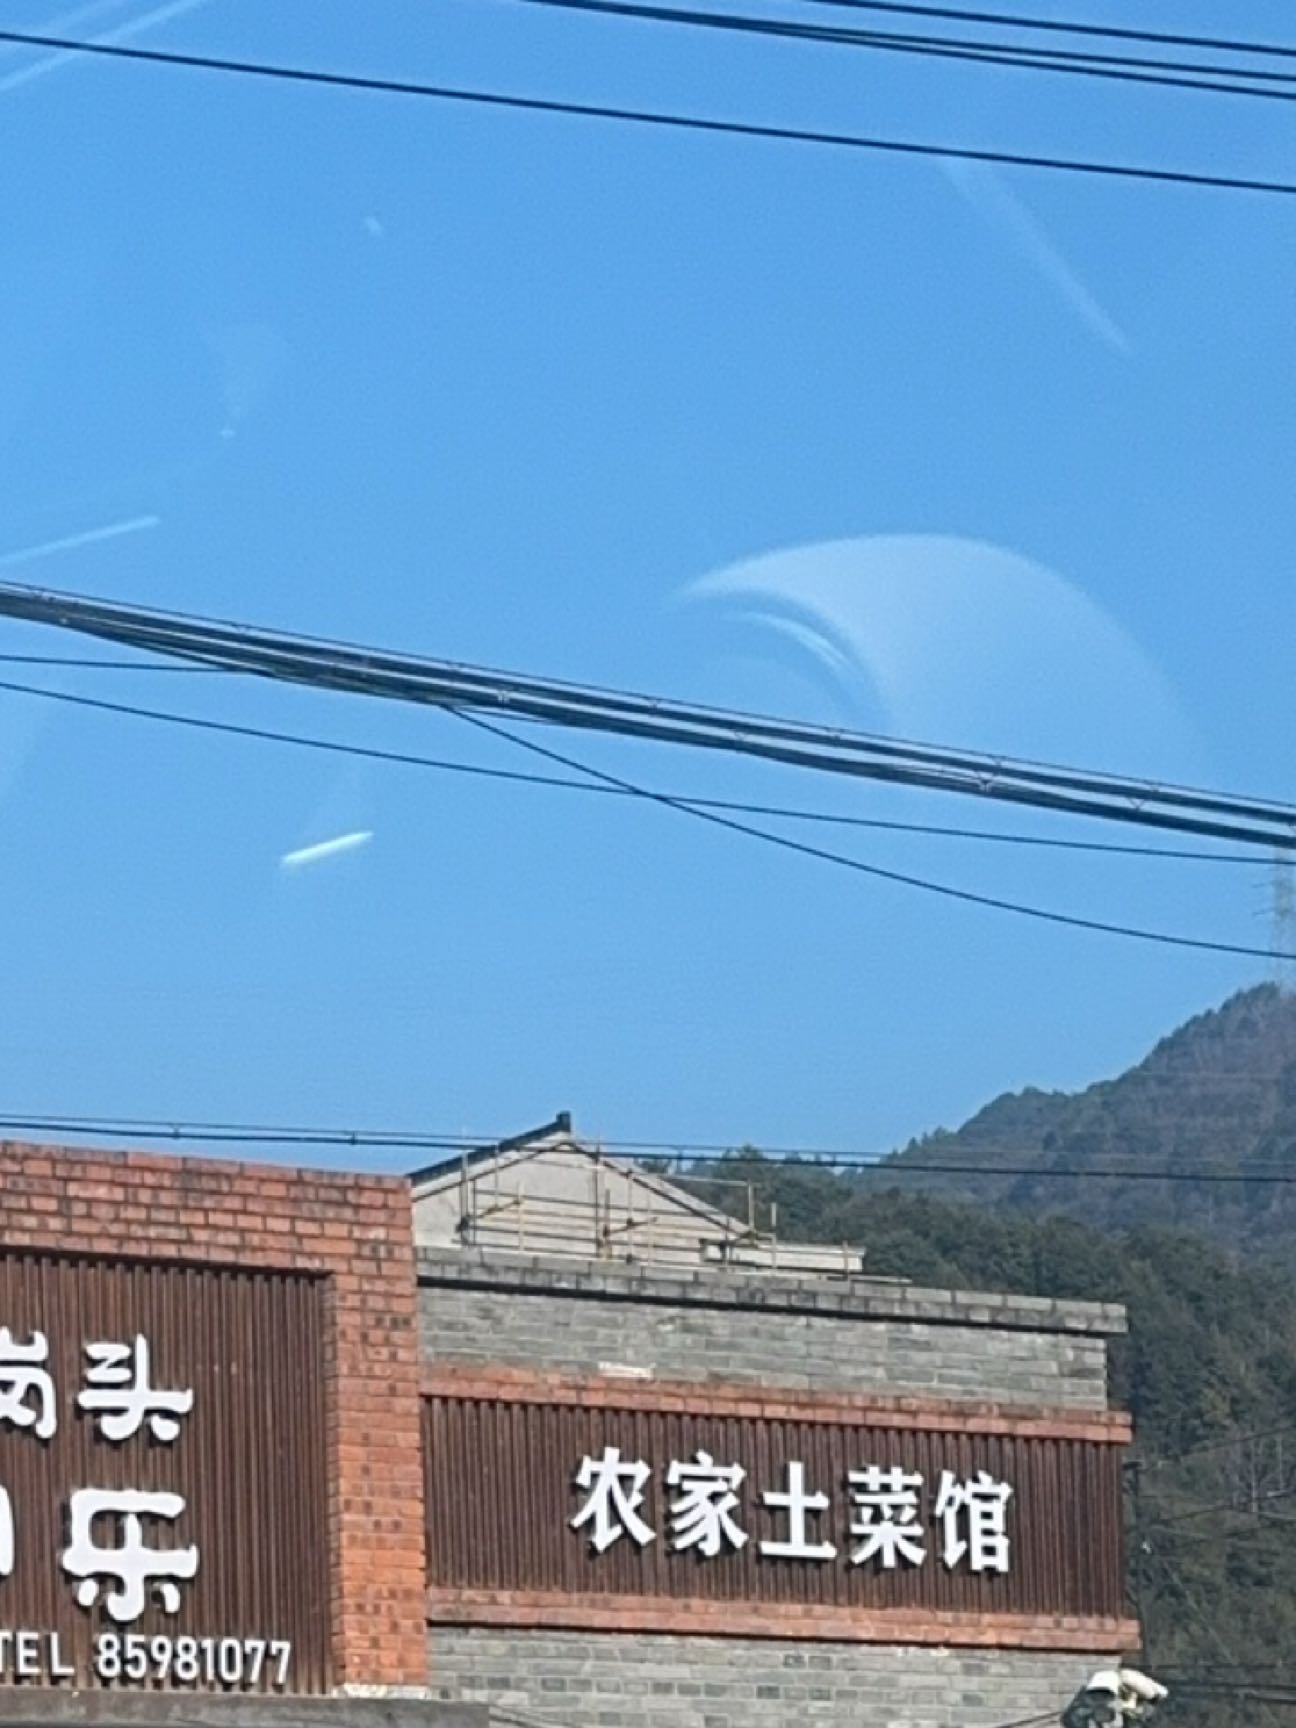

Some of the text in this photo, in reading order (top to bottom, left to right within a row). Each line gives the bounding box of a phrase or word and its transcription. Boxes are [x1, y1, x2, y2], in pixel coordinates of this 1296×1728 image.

[570, 1446, 1013, 1573] 农家土菜馆
[96, 1632, 292, 1684] 85981077
